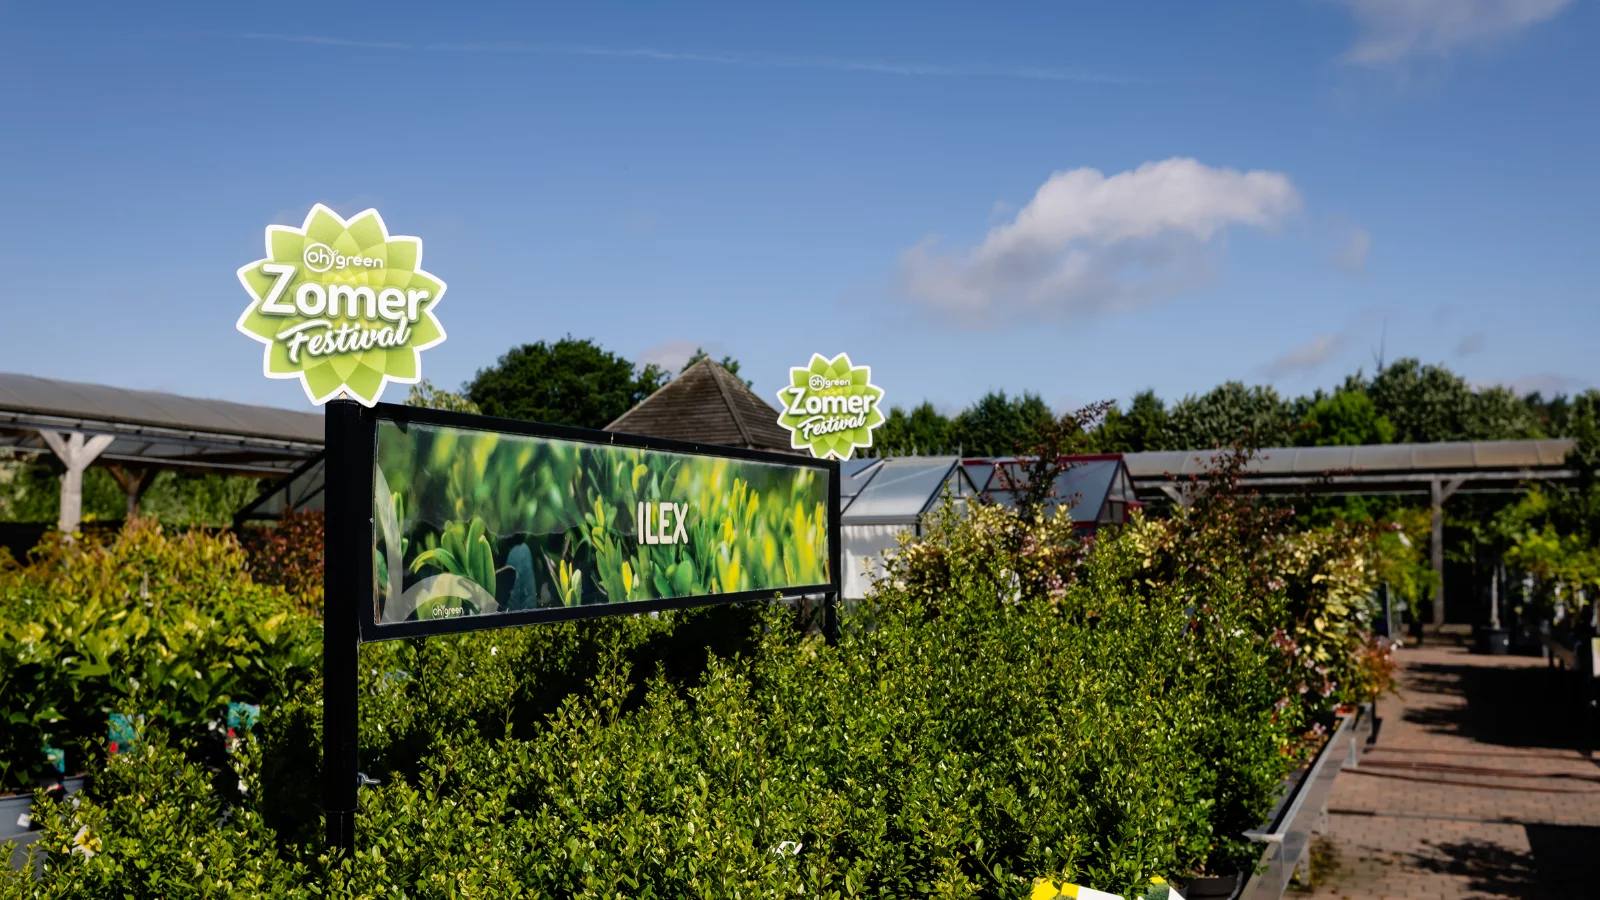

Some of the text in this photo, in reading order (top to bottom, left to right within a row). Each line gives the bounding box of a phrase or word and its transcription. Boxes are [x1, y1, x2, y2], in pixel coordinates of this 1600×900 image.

[260, 263, 429, 321] Zomer
[276, 316, 412, 363] Festival
[788, 387, 876, 415] Zomer
[797, 411, 867, 440] Festival
[637, 501, 689, 545] ILEX
